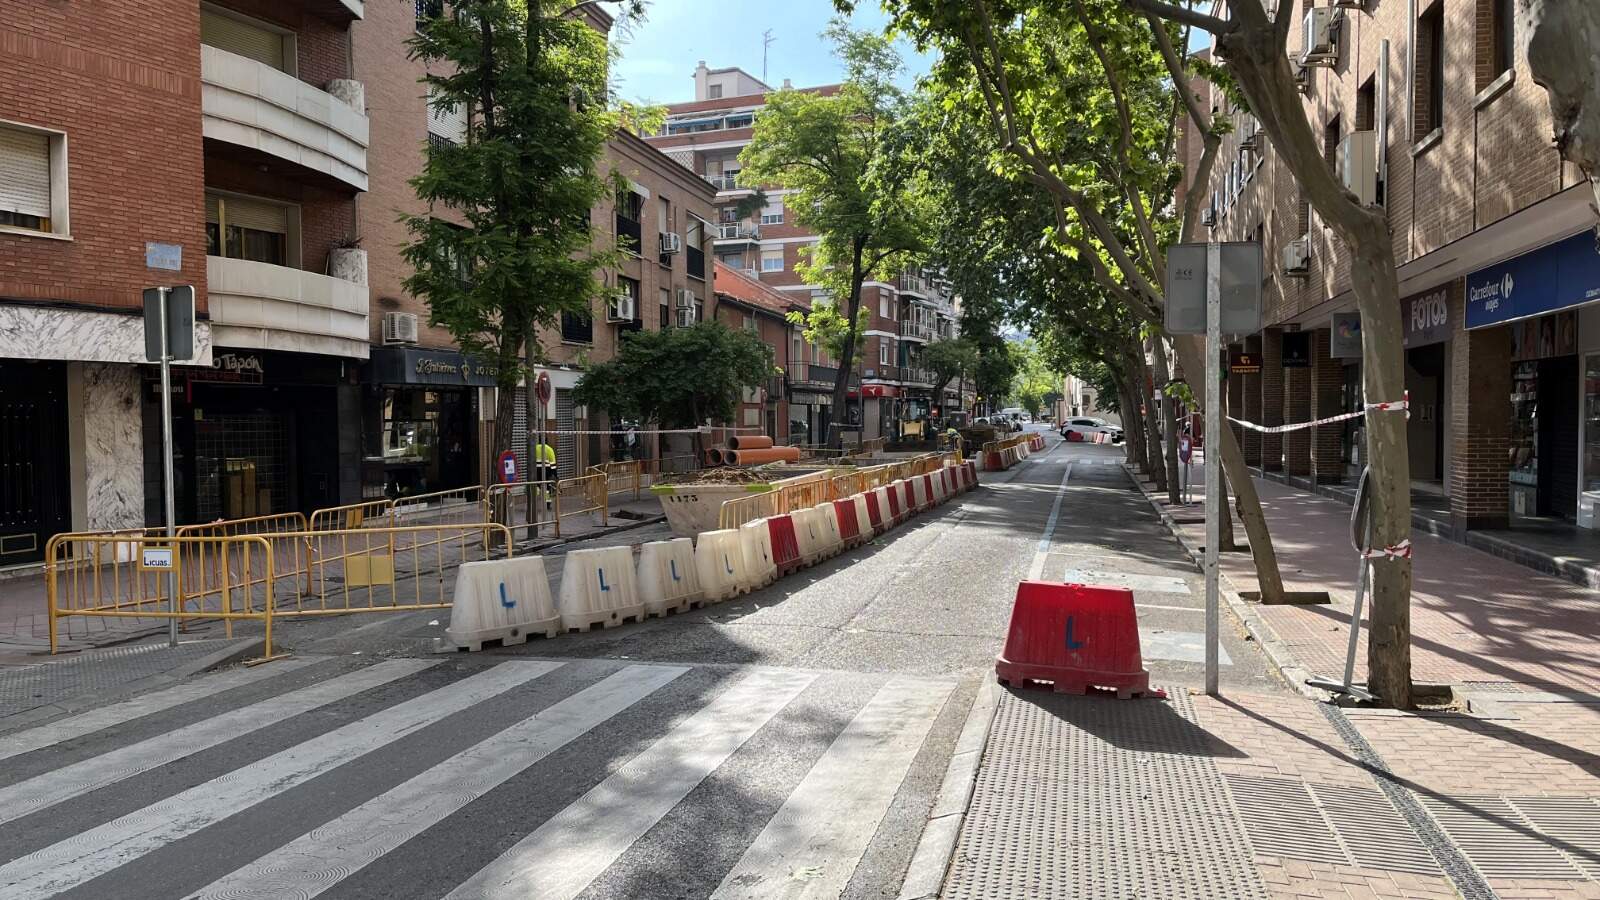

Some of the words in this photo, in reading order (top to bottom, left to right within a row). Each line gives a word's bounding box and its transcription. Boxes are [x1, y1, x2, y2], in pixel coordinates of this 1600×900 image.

[1469, 281, 1500, 302] Carrefour
[1411, 289, 1447, 332] FOTOS
[598, 567, 610, 592] L
[671, 559, 681, 581] L
[499, 582, 517, 609] L
[1065, 615, 1083, 650] L
